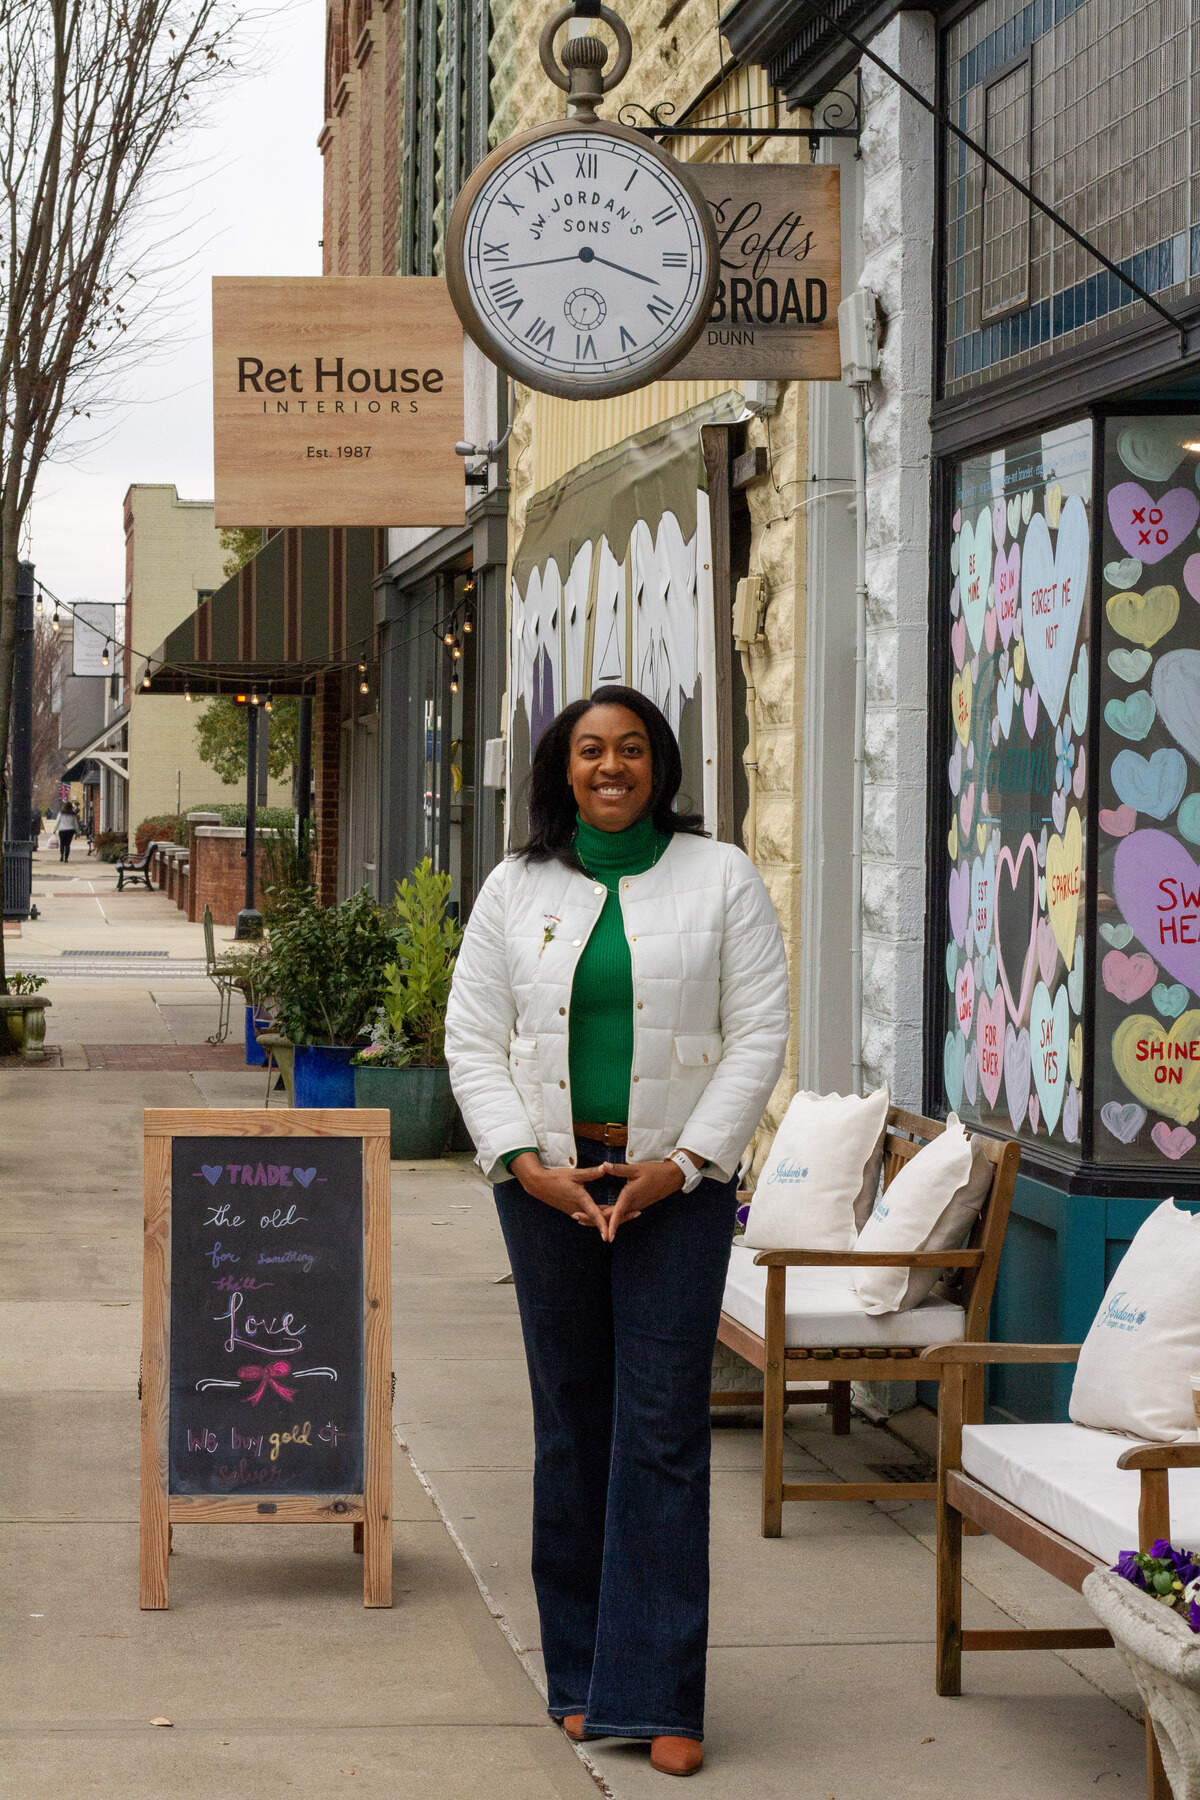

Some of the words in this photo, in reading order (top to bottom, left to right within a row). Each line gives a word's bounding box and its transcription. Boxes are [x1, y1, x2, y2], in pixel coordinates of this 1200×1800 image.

[575, 152, 598, 179] XII
[551, 191, 643, 235] JORDAN'S
[563, 219, 611, 234] SONS
[707, 198, 817, 280] Lofts
[708, 331, 754, 345] DUNN
[236, 357, 304, 393] Ret
[314, 357, 444, 393] House
[262, 400, 419, 413] INTERIORS
[306, 446, 333, 458] Est.
[337, 446, 372, 458] 1987
[1130, 507, 1163, 525] XO
[1138, 529, 1169, 546] XO
[1001, 598, 1014, 621] LOVE
[1031, 583, 1057, 617] FORGET
[1062, 577, 1071, 608] ME
[1045, 624, 1058, 649] NOT
[1051, 865, 1079, 906] SPARKLE
[960, 999, 972, 1021] LOVE
[985, 1024, 997, 1046] FOR
[1040, 1016, 1055, 1048] SAY
[982, 1048, 999, 1076] EVER
[1135, 1040, 1200, 1062] SHINE
[1042, 1050, 1058, 1084] YES
[1154, 1065, 1183, 1085] ON
[226, 1162, 294, 1187] TRADE
[203, 1203, 246, 1227] the
[260, 1204, 308, 1228] old
[204, 1241, 240, 1268] for
[213, 1291, 307, 1355] Love
[268, 1420, 313, 1461] gold
